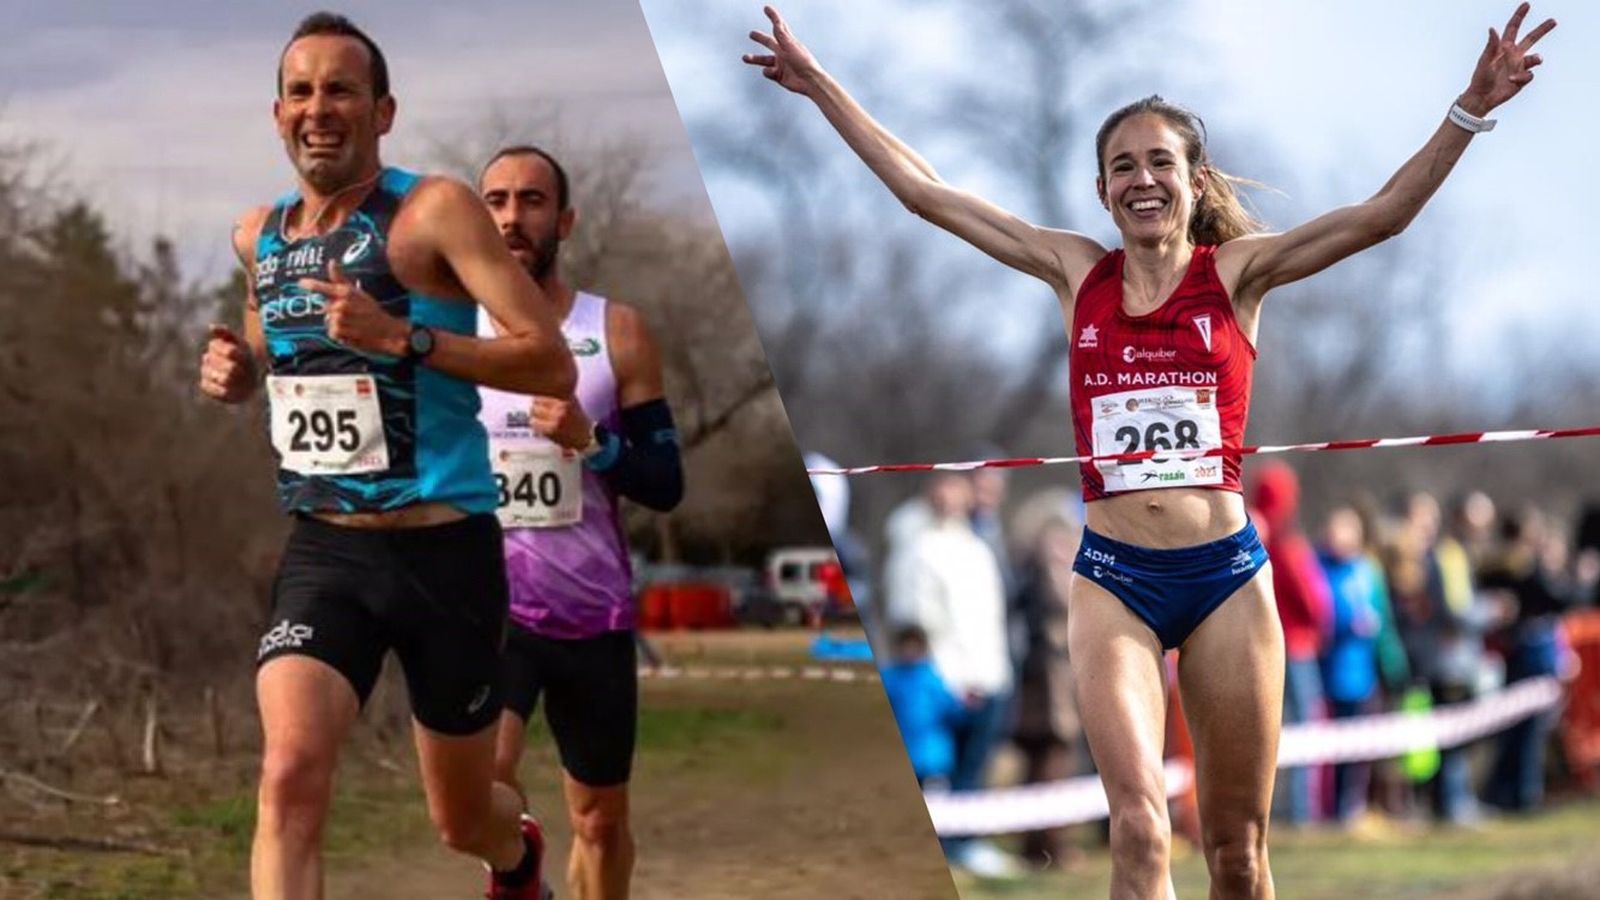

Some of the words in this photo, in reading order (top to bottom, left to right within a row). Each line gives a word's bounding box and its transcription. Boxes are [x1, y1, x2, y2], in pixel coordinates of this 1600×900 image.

[1084, 373, 1113, 387] A.D.
[1117, 371, 1218, 386] MARATHON
[287, 409, 361, 453] 295
[1114, 419, 1201, 466] 268
[1084, 547, 1116, 567] ADM
